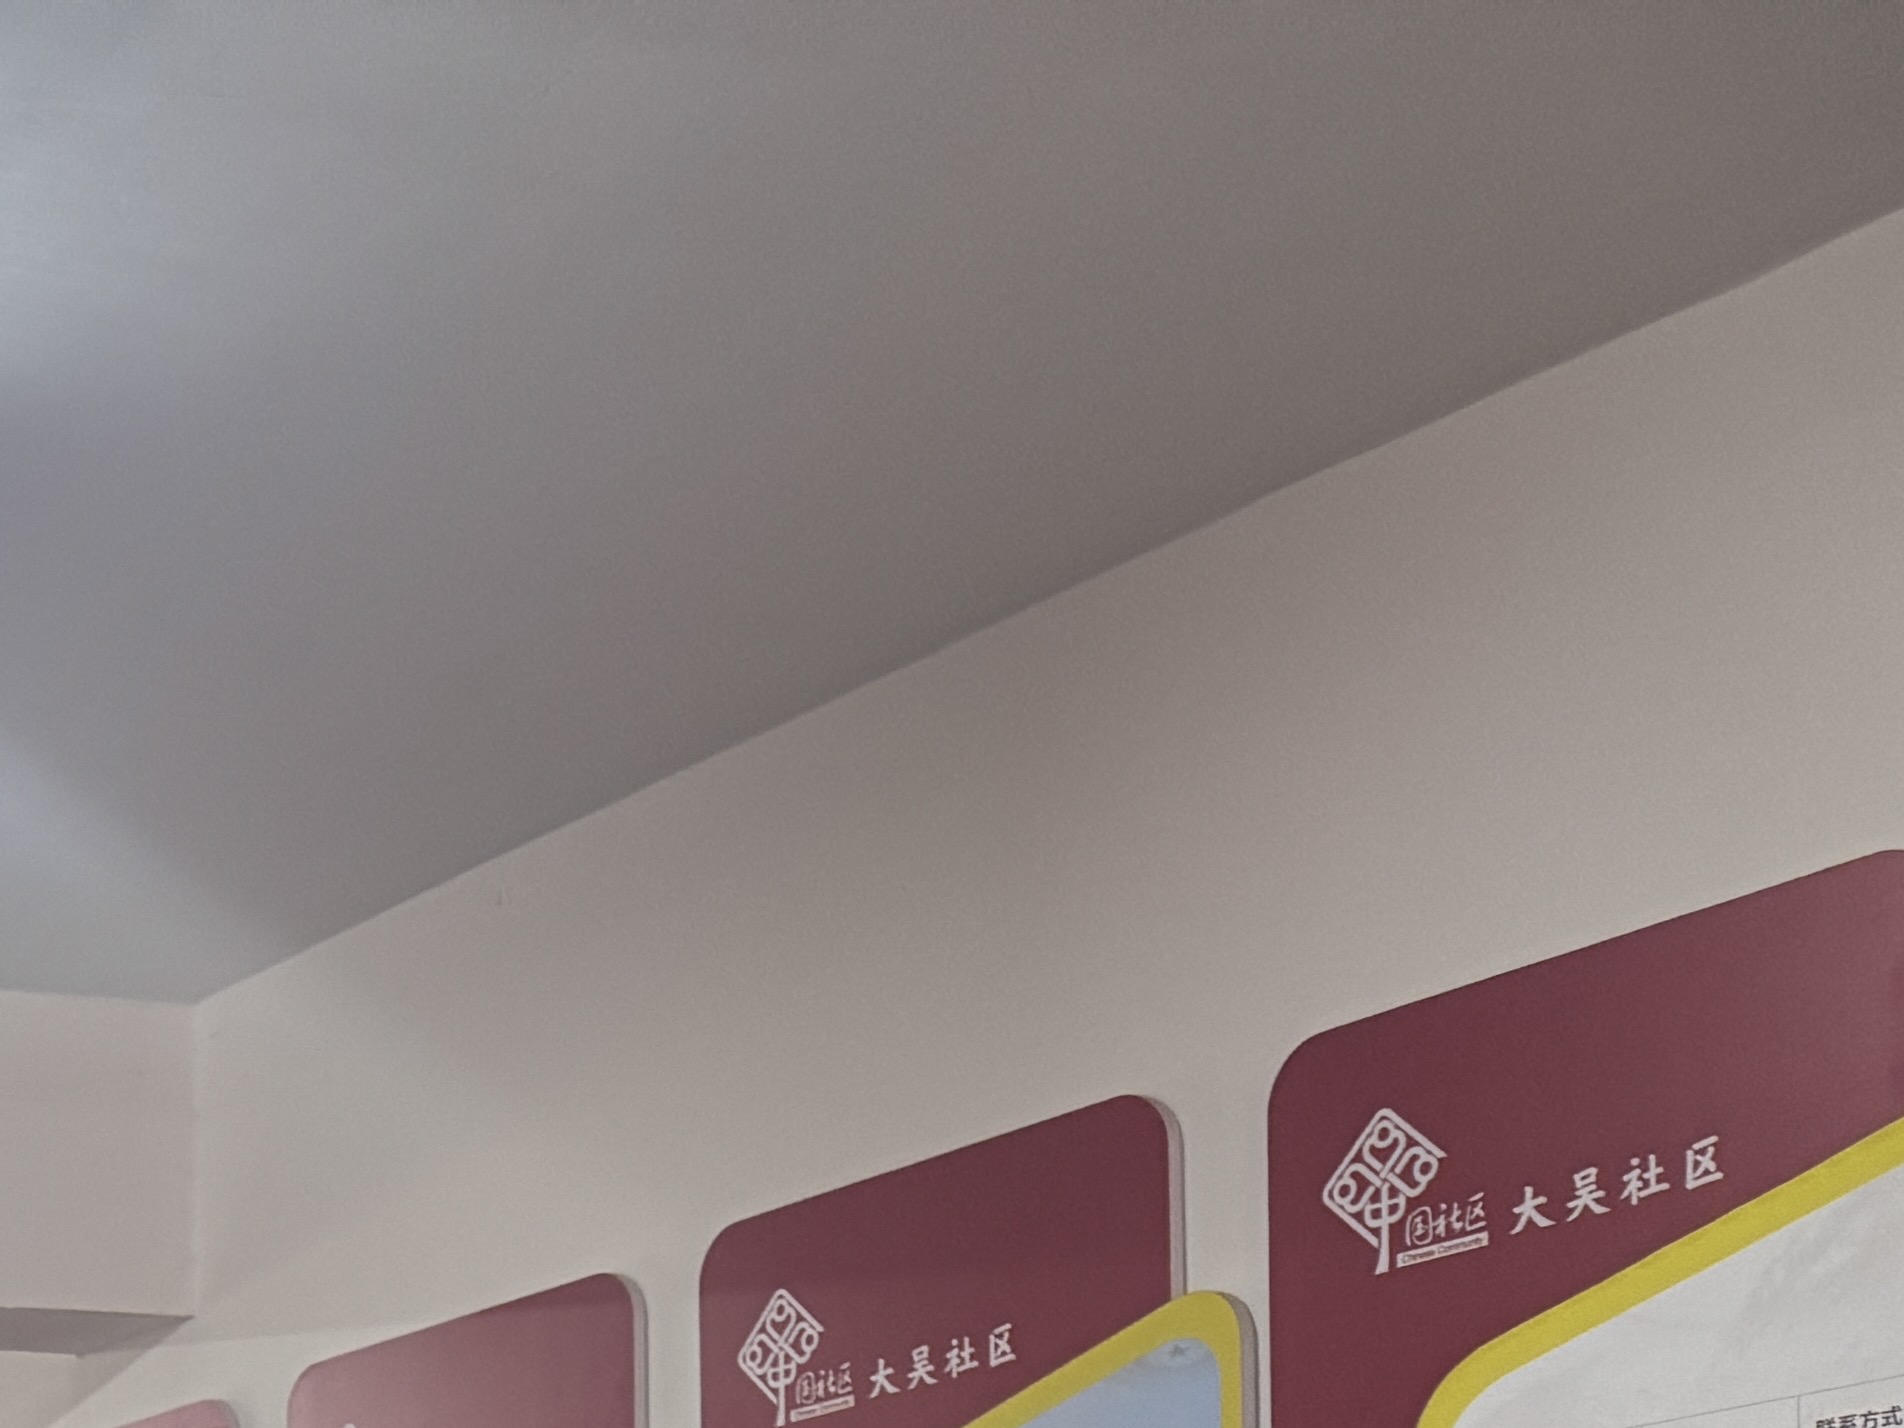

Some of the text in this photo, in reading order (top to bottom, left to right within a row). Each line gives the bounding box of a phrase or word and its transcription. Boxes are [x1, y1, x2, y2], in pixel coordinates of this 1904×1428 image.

[1509, 1134, 1724, 1235] 大吴社区
[867, 1323, 1017, 1399] 大吴社区
